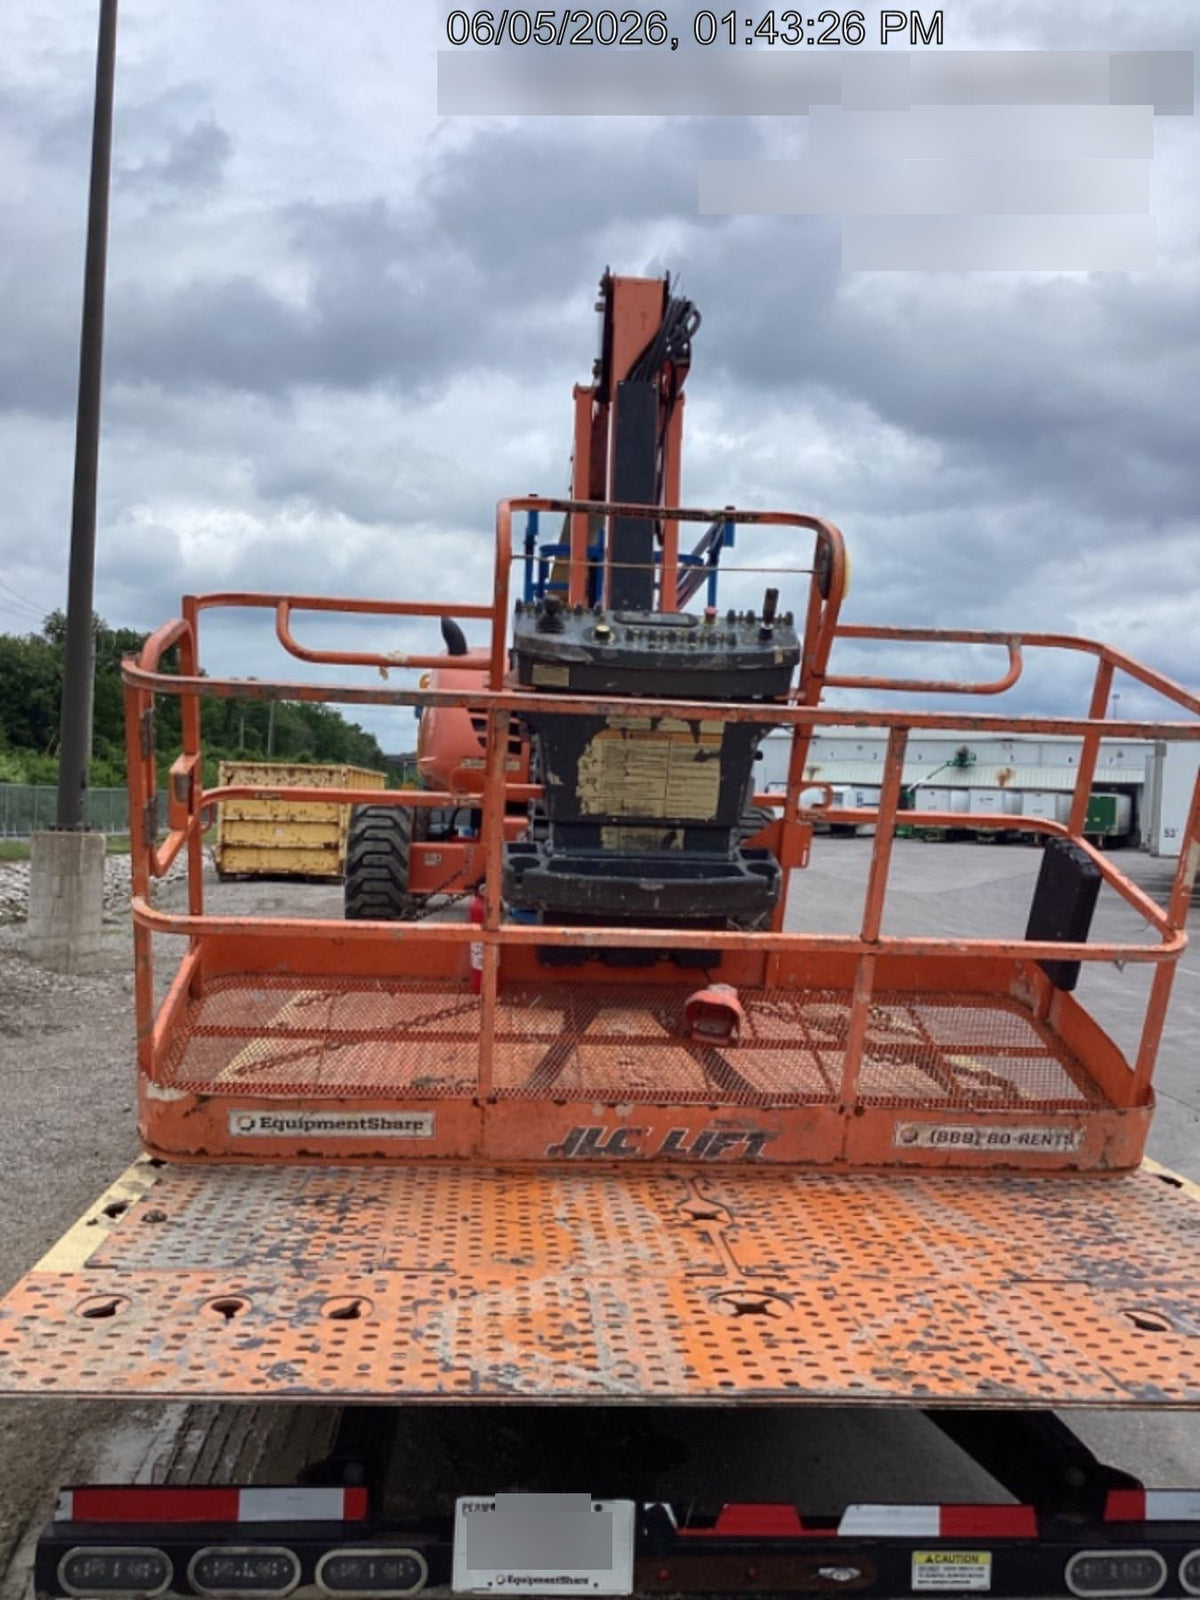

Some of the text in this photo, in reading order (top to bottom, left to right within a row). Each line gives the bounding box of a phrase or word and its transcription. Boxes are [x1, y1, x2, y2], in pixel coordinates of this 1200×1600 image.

[259, 1115, 425, 1131] EquipmentShare
[934, 1553, 979, 1564] CAUTION
[506, 1574, 589, 1586] EquipmentShare
